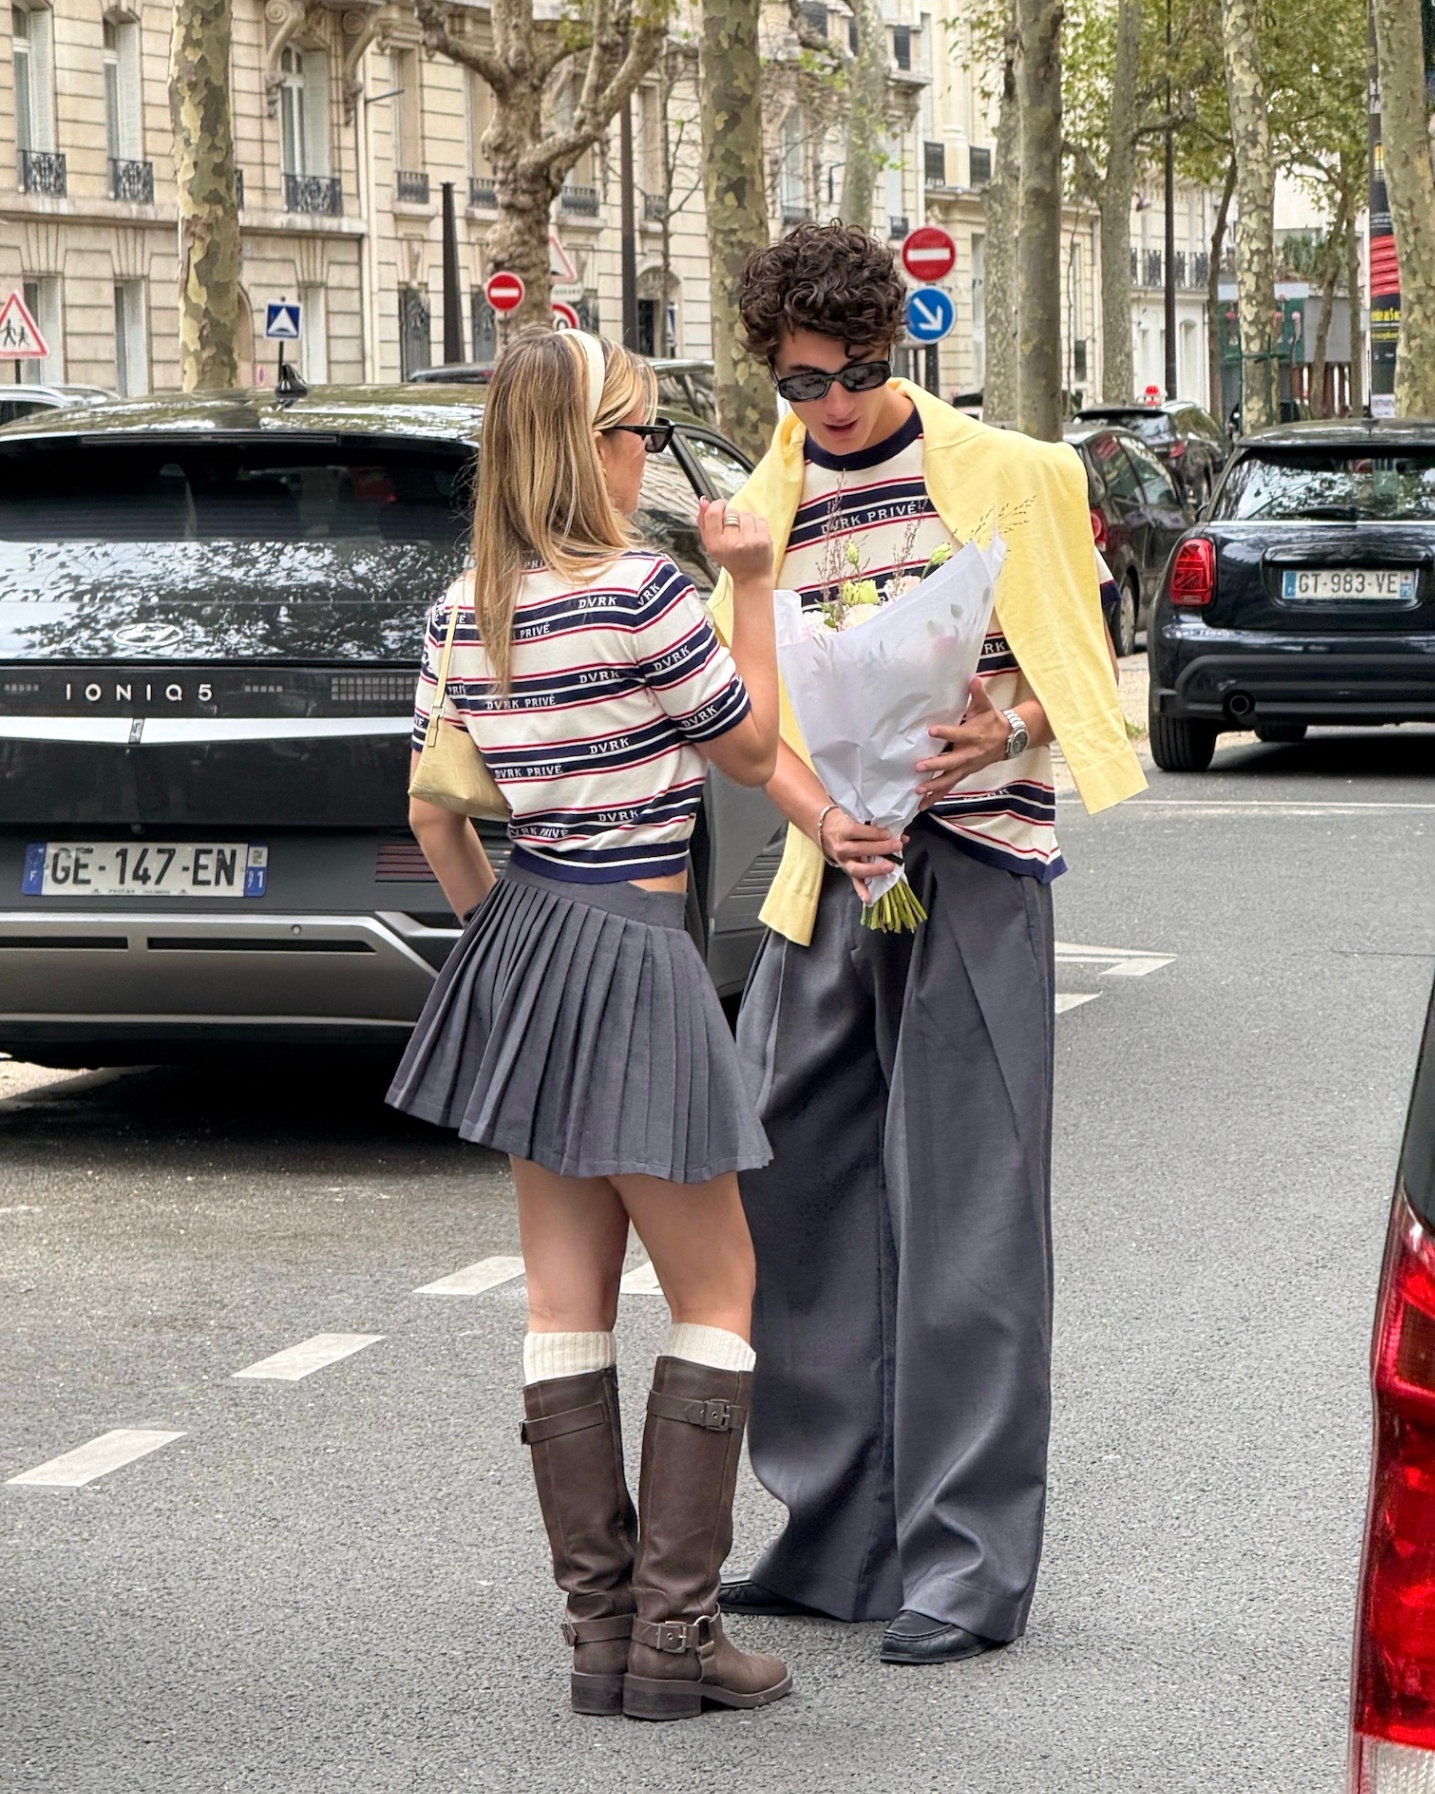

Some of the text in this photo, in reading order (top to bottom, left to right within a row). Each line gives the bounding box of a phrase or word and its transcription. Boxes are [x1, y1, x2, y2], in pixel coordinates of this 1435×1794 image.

[867, 500, 917, 522] PRIVÉ
[1298, 573, 1398, 593] GT-983-VE
[579, 596, 618, 609] DVRK
[519, 622, 551, 639] PRIVÉ
[653, 645, 690, 671] DVRK
[579, 669, 620, 684] DVRK
[65, 683, 213, 701] IONIQ 5
[524, 693, 556, 708] PRIVÉ
[681, 705, 718, 728] DVRK
[589, 737, 630, 754] DVRK
[494, 763, 563, 779] DVRK PRIVÉ
[598, 809, 640, 822] DVRK
[29, 869, 37, 882] F
[51, 847, 237, 887] GE-147-EN
